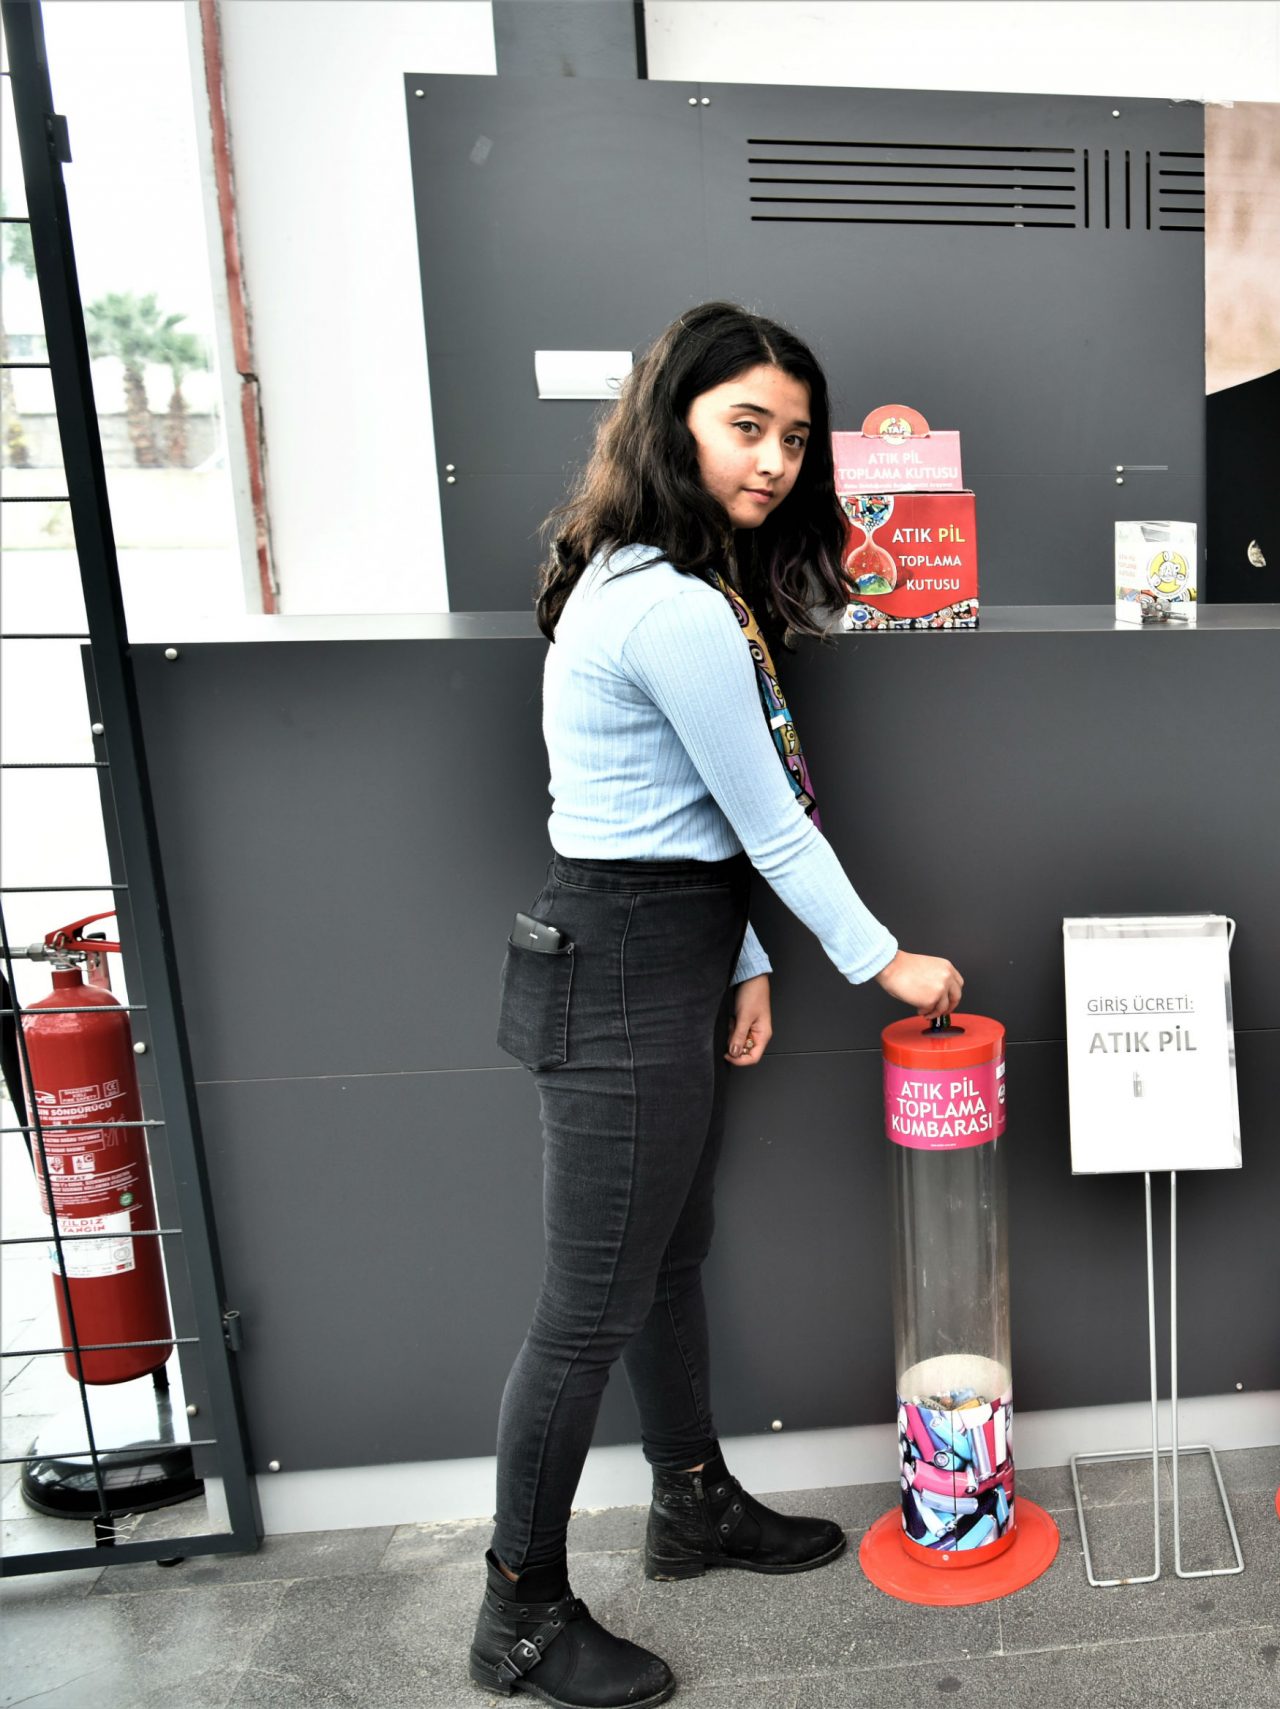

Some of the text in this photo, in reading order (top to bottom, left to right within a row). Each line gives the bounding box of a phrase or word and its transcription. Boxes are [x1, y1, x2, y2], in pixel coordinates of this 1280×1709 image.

[868, 450, 923, 465] ATIK PİL
[839, 467, 958, 480] TOPLAMA KUTUSU
[892, 524, 965, 543] ATIK PİL
[898, 555, 962, 567] TOPLAMA
[906, 578, 960, 591] KUTUSU
[1087, 994, 1194, 1014] GİRİŞ ÜCRETİ:
[1089, 1025, 1197, 1054] ATIK PİL
[901, 1077, 980, 1100] ATIK PİL
[51, 1101, 112, 1116] SÖNDÜRÜCÜ
[896, 1097, 986, 1119] TOPLAMA
[892, 1112, 993, 1138] KUMBARASI
